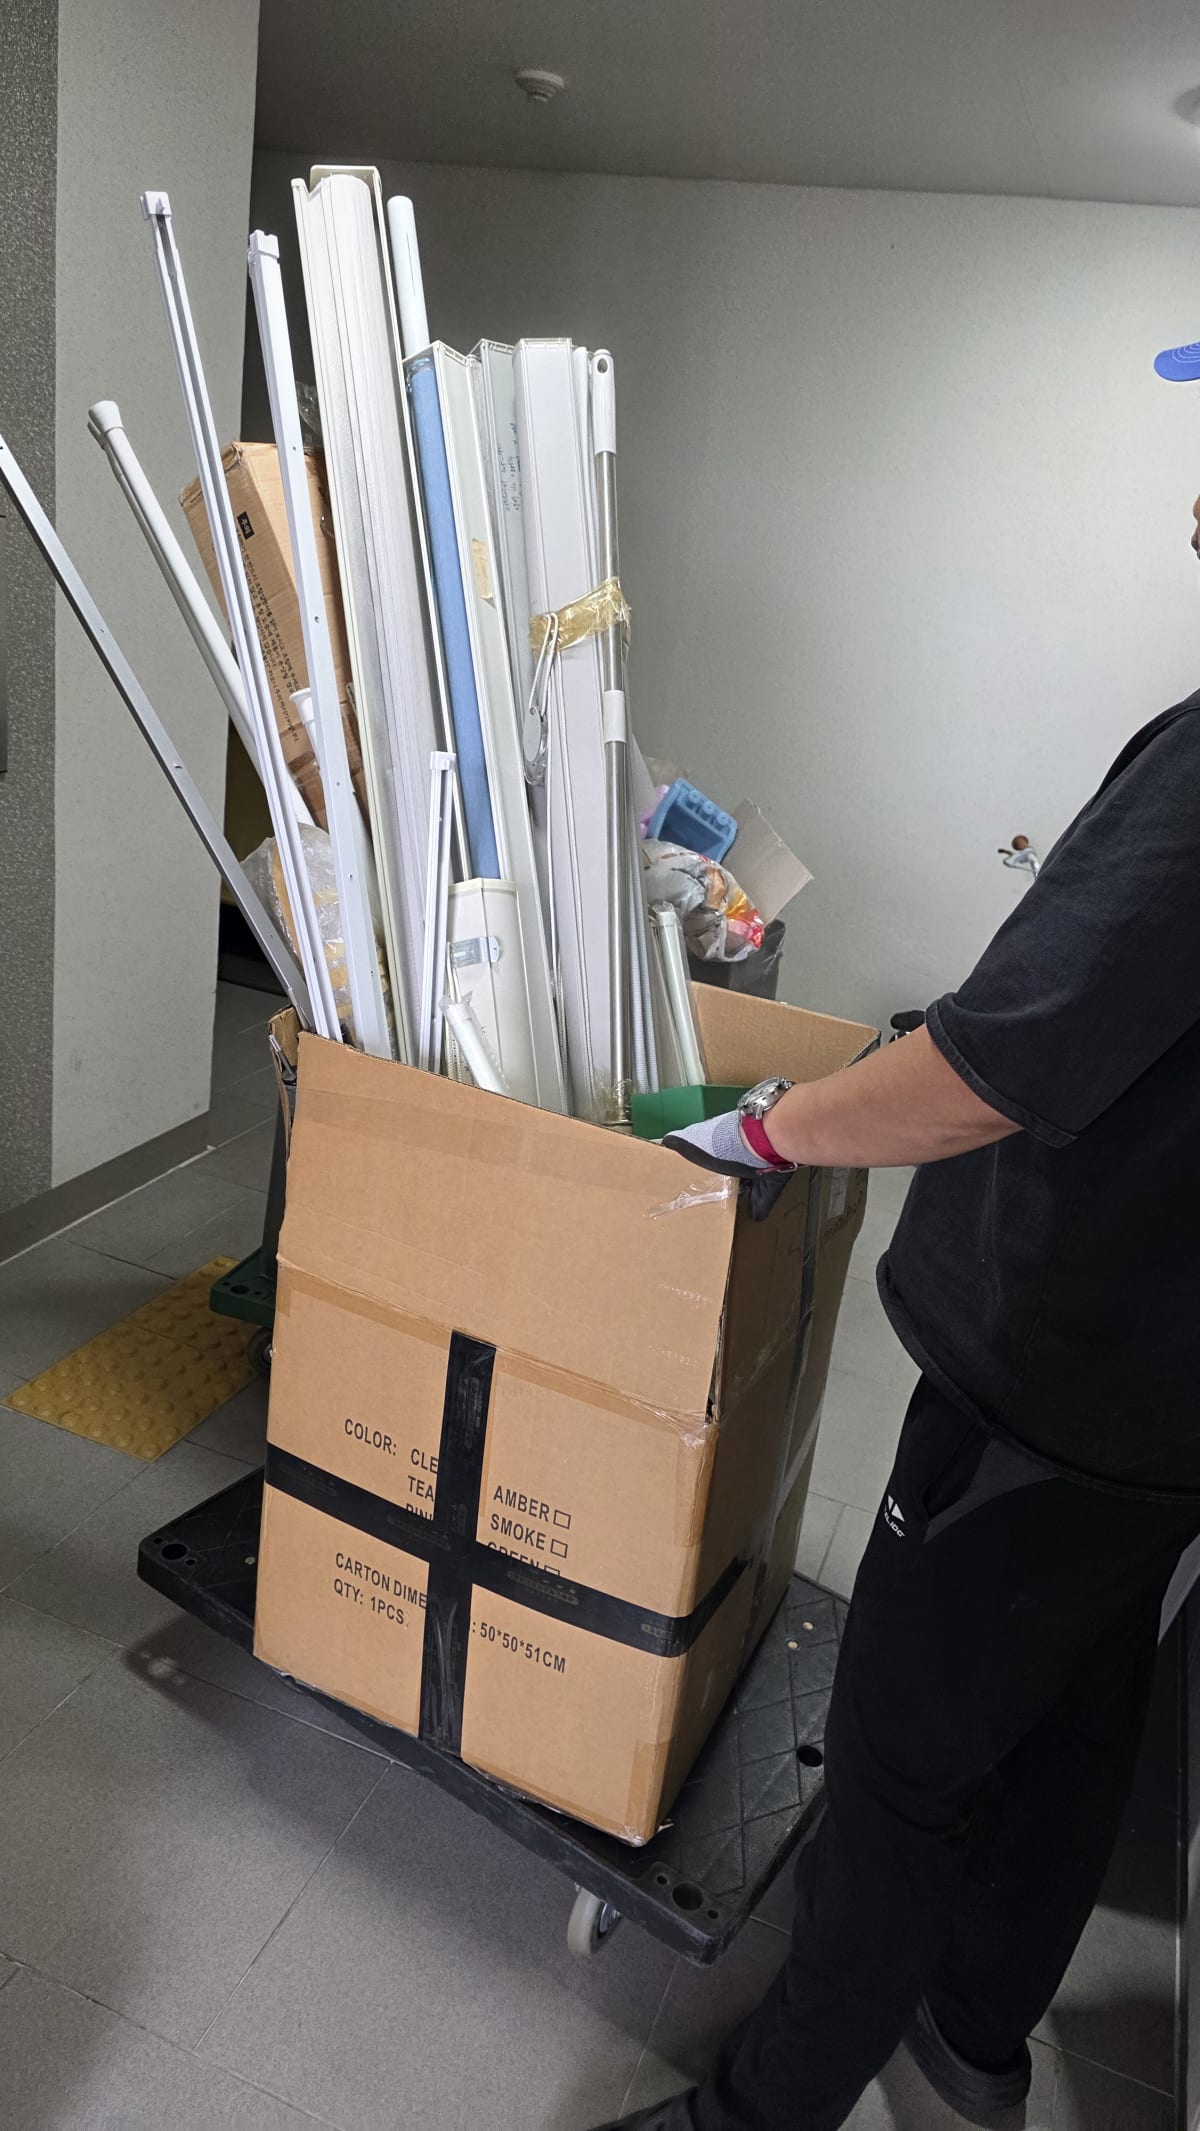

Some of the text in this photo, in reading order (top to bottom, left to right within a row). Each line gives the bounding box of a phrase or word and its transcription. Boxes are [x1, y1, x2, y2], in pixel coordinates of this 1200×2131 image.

[345, 1418, 439, 1474] COLOR: CLE
[407, 1475, 434, 1502] TEA
[493, 1485, 550, 1522] AMBER
[490, 1513, 546, 1551] SMOKE
[333, 1578, 364, 1605] QTY:
[335, 1552, 391, 1592] CARTON
[393, 1579, 428, 1610] DIME
